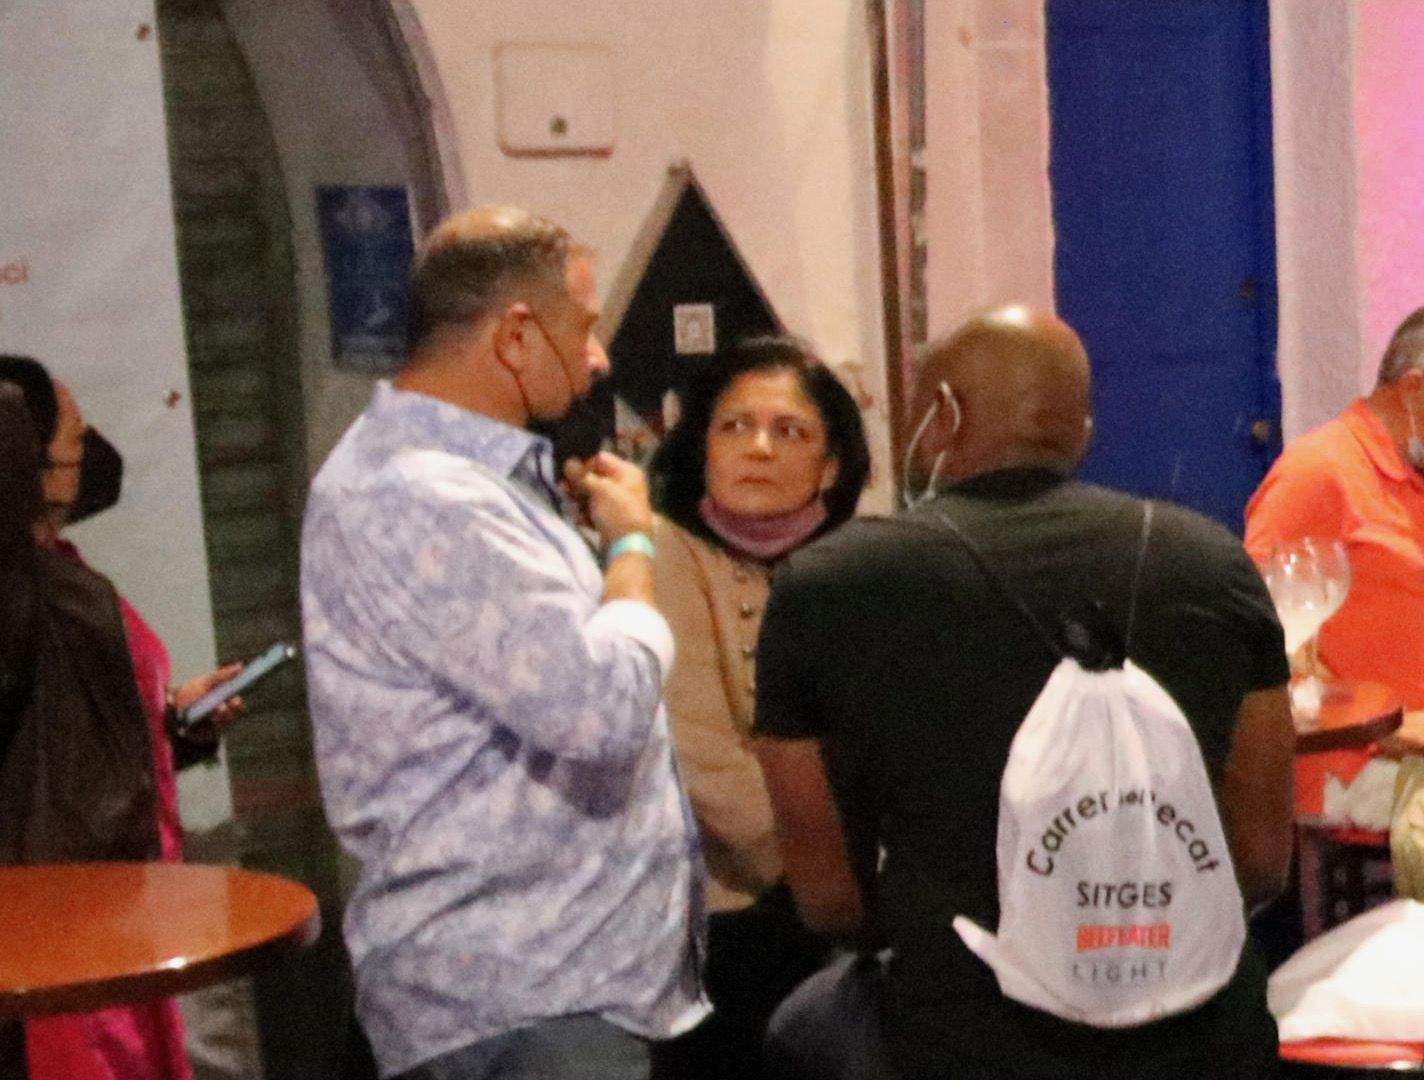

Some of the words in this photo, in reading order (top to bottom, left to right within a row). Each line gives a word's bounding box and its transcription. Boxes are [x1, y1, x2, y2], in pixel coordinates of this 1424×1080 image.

[1026, 790, 1108, 877] Carrer
[1150, 789, 1220, 874] ecat
[1077, 880, 1172, 907] SITGES
